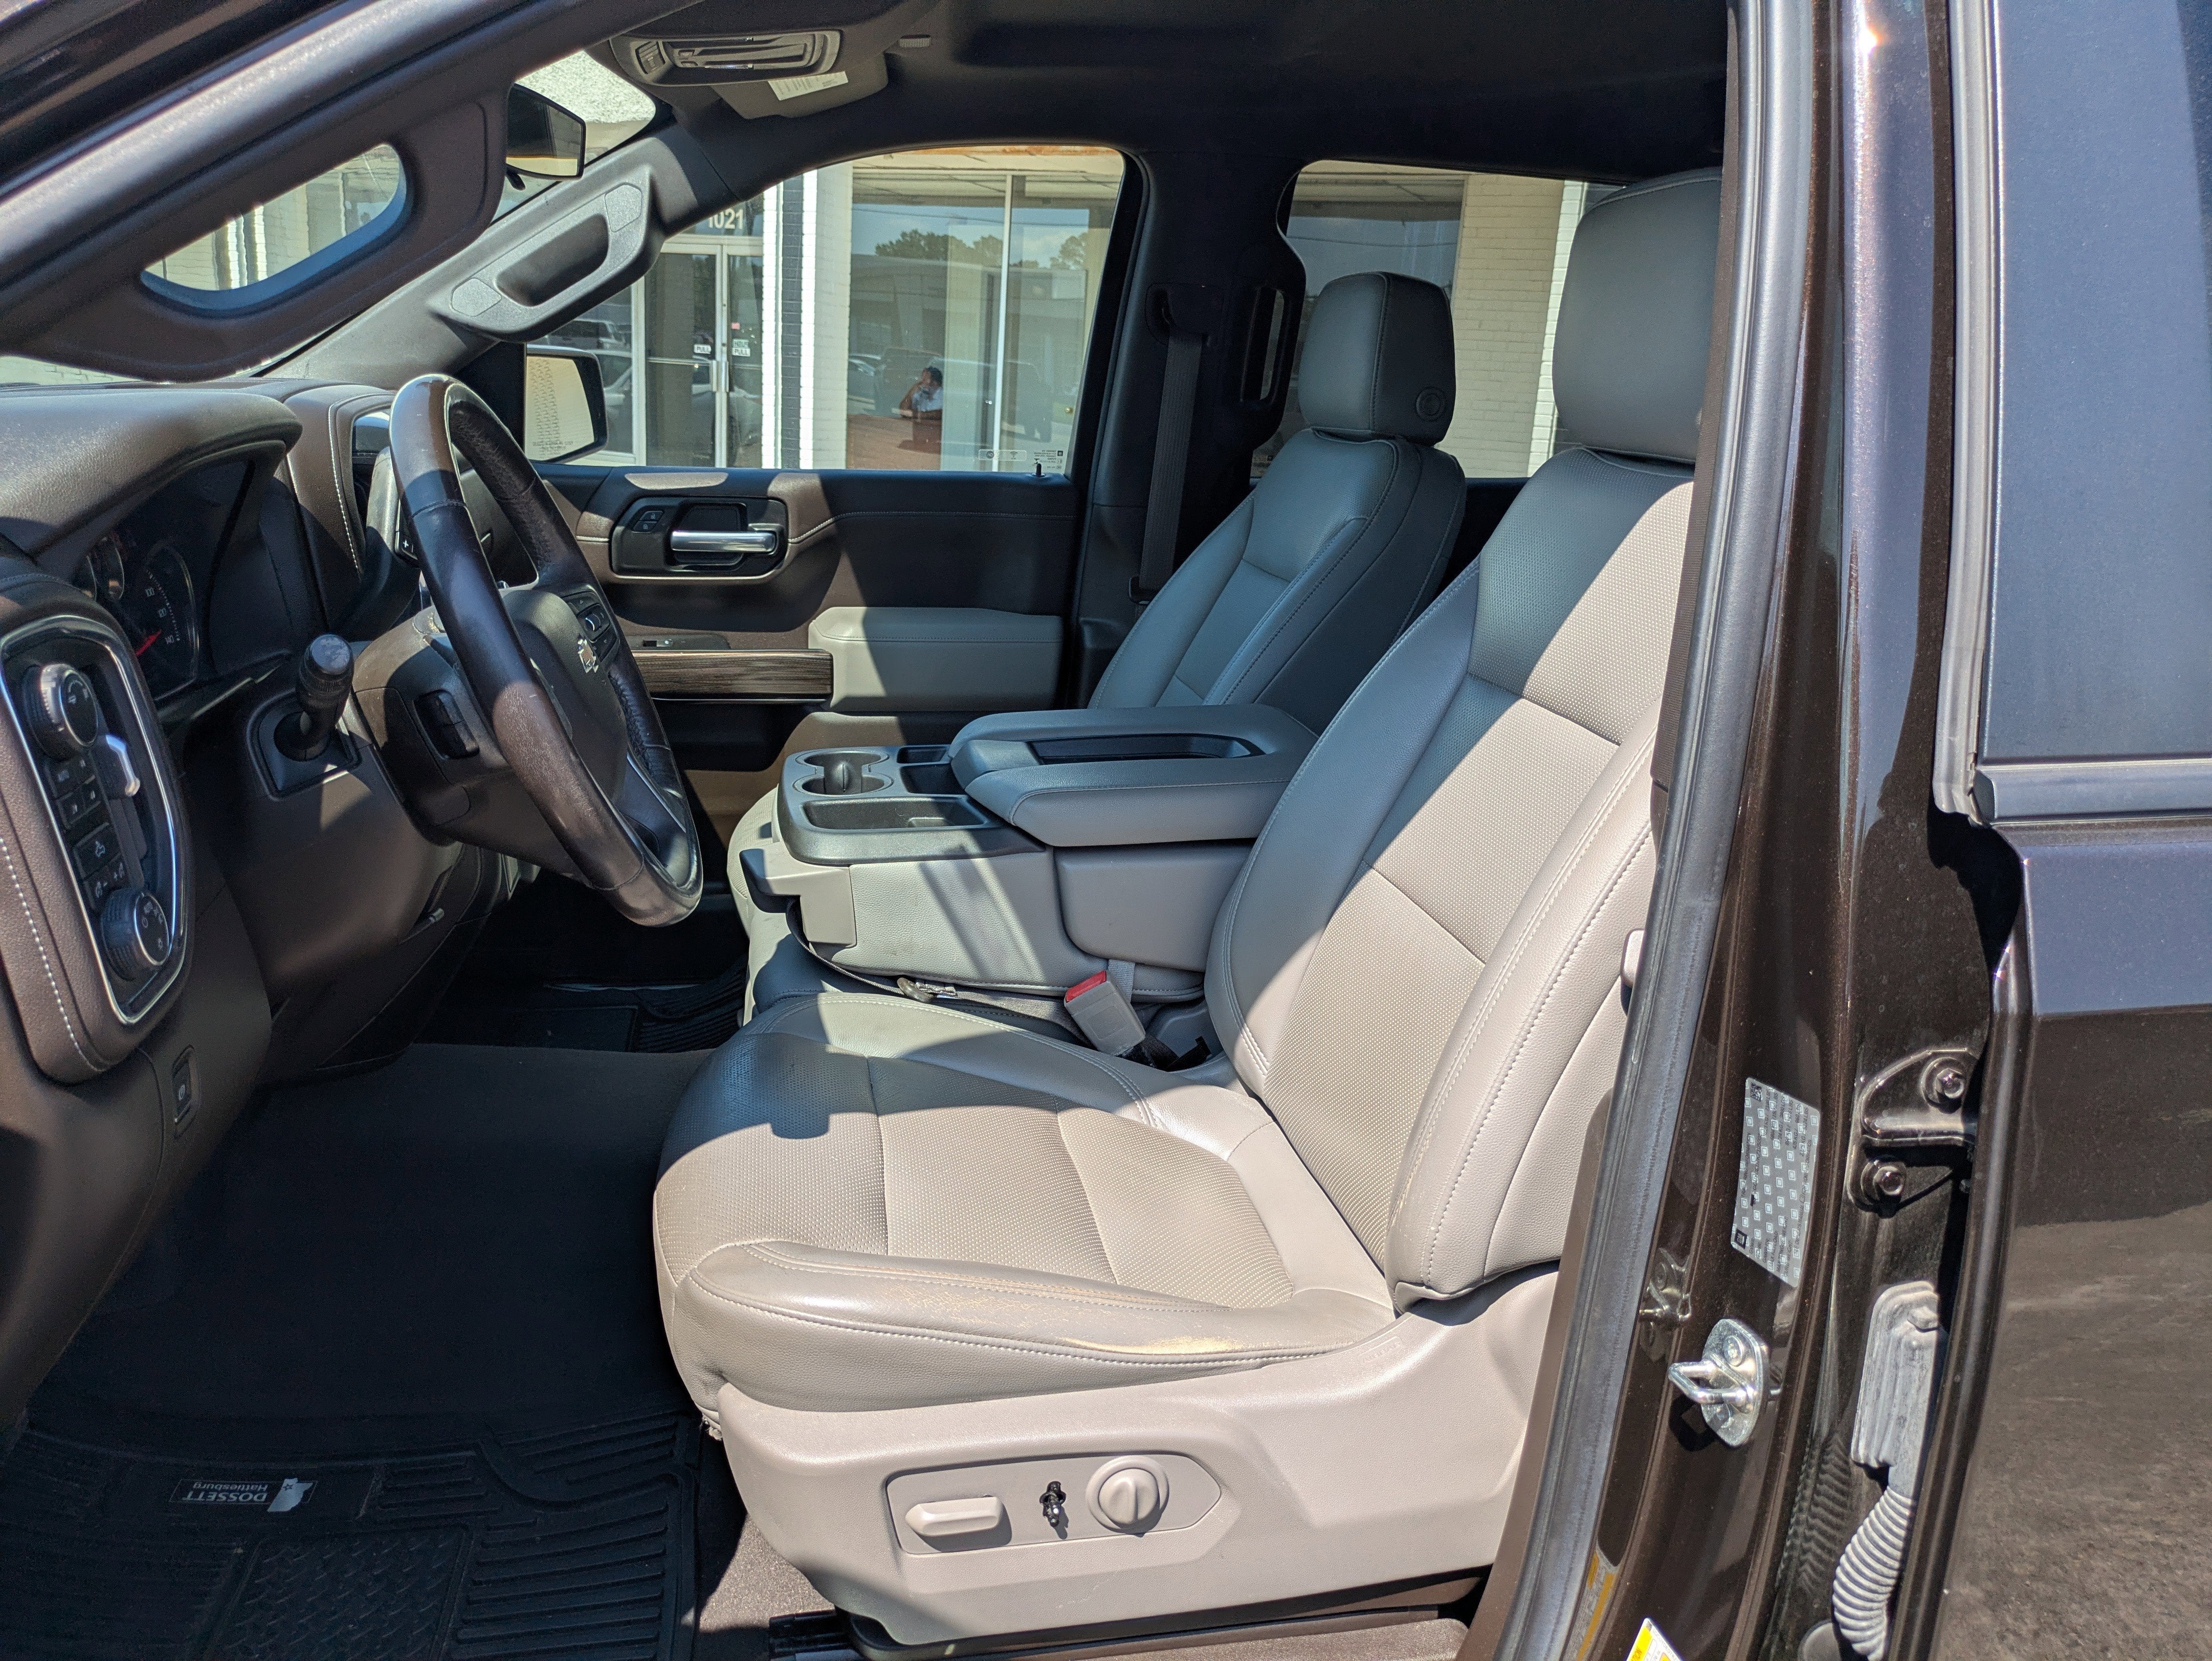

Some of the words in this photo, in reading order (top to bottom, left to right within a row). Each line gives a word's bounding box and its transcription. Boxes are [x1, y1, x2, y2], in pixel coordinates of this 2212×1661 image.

[708, 208, 743, 229] 1021
[165, 635, 174, 644] 140
[193, 1482, 268, 1491] Hattiesburg
[182, 1491, 268, 1503] DOSSETT
